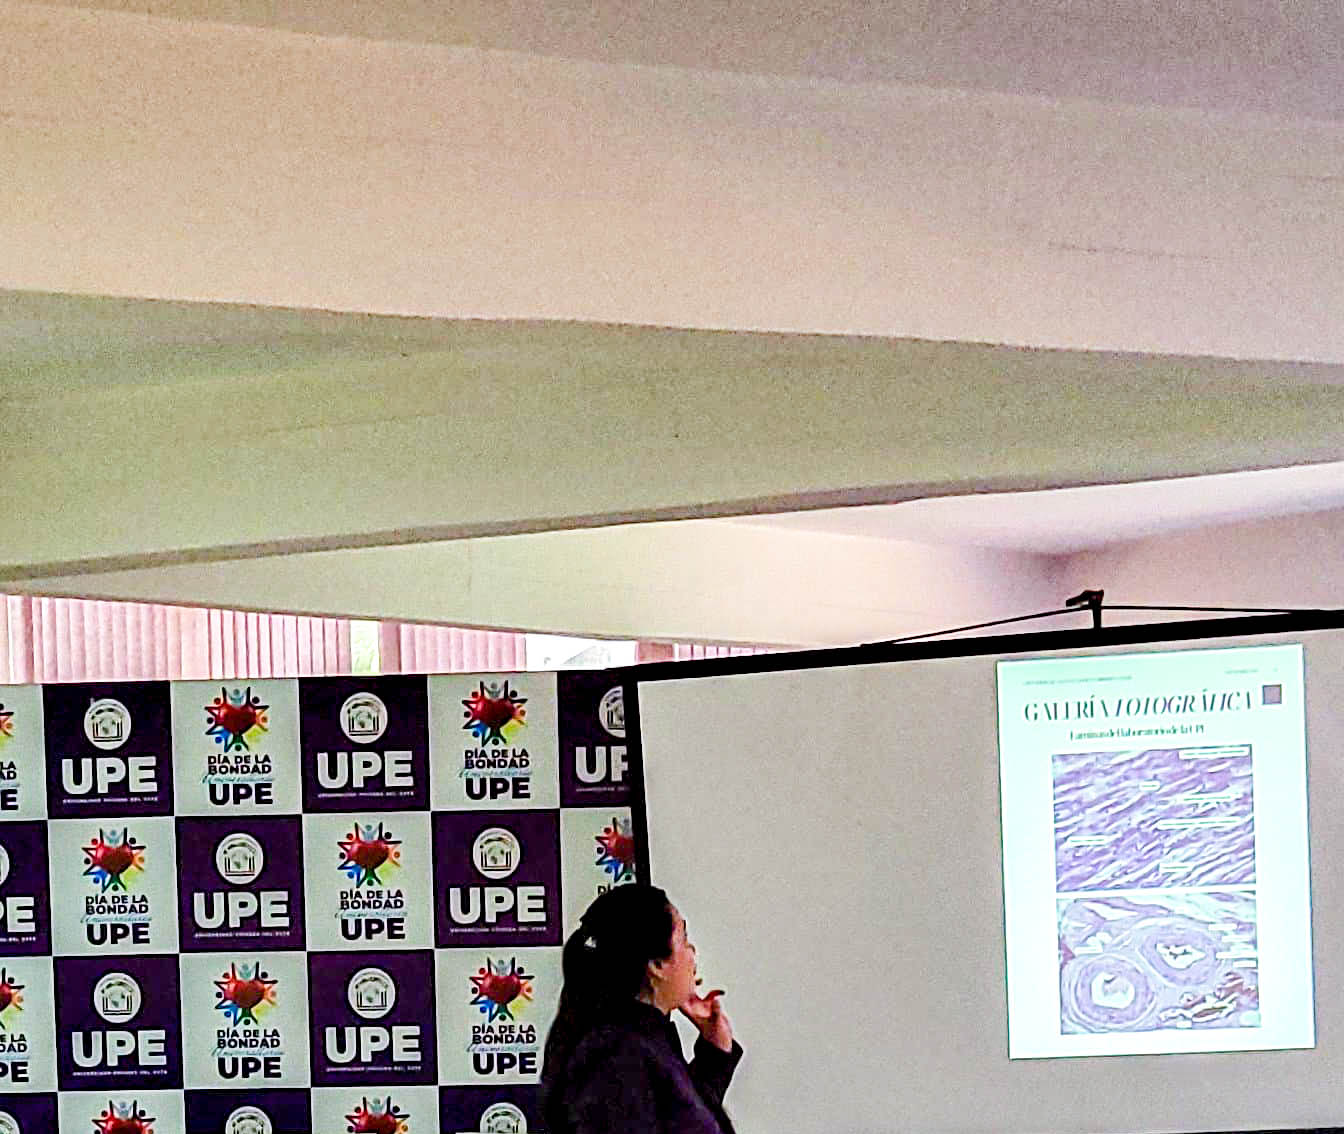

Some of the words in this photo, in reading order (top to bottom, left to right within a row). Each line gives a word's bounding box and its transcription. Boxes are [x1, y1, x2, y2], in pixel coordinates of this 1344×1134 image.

[1024, 694, 1109, 721] GALERÍA
[234, 754, 251, 764] DE
[255, 754, 271, 763] LA
[491, 749, 509, 758] DE
[512, 749, 529, 758] LA
[0, 761, 16, 770] LA
[208, 764, 271, 775] BONDAD
[317, 751, 414, 789] UPE
[465, 758, 529, 769] BONDAD
[61, 756, 158, 795] UPE
[209, 783, 273, 806] UPE
[465, 777, 530, 800] UPE
[111, 895, 128, 904] DE
[132, 894, 148, 904] LA
[366, 890, 383, 899] DE
[387, 890, 403, 898] LA
[86, 903, 149, 915] BONDAD
[193, 891, 290, 929] UPE
[449, 886, 546, 925] UPE
[86, 923, 151, 945] UPE
[341, 917, 405, 940] UPE
[243, 1029, 259, 1038] DE
[263, 1028, 280, 1037] LA
[499, 1025, 515, 1034] DE
[519, 1024, 535, 1033] LA
[10, 1034, 26, 1042] LA
[217, 1038, 280, 1049] BONDAD
[325, 1025, 421, 1063] UPE
[472, 1033, 536, 1045] BONDAD
[71, 1030, 167, 1067] UPE
[218, 1057, 282, 1079] UPE
[472, 1052, 537, 1075] UPE
